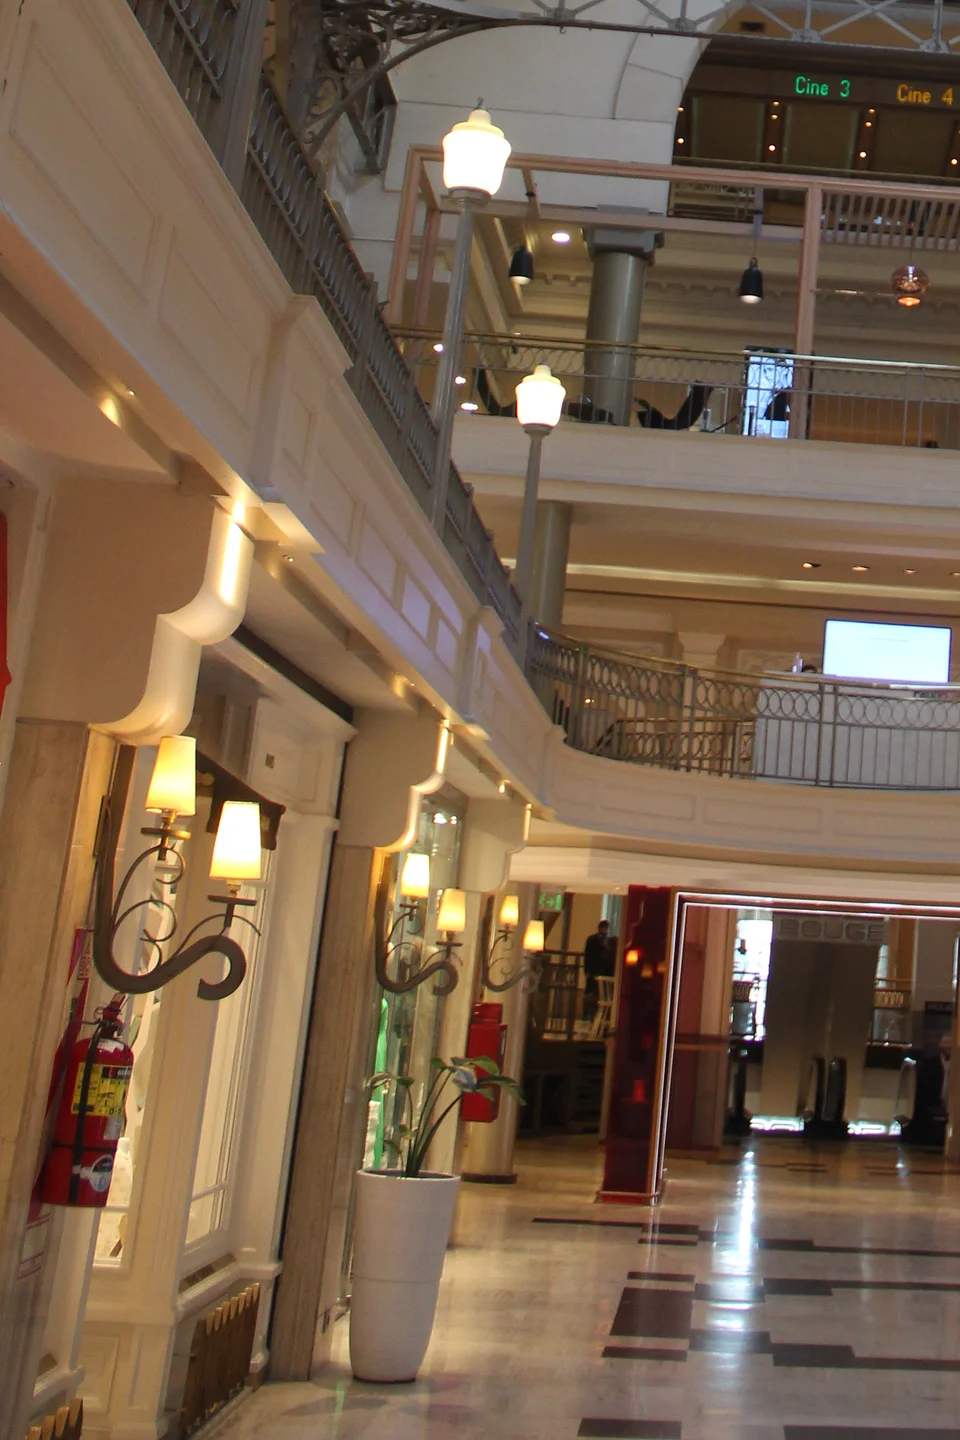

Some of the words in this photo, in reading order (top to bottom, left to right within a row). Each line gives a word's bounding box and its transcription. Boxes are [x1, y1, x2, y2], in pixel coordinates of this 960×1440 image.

[795, 75, 829, 96] Cine
[840, 79, 850, 99] 3
[896, 83, 931, 105] Cine
[941, 87, 953, 106] 4
